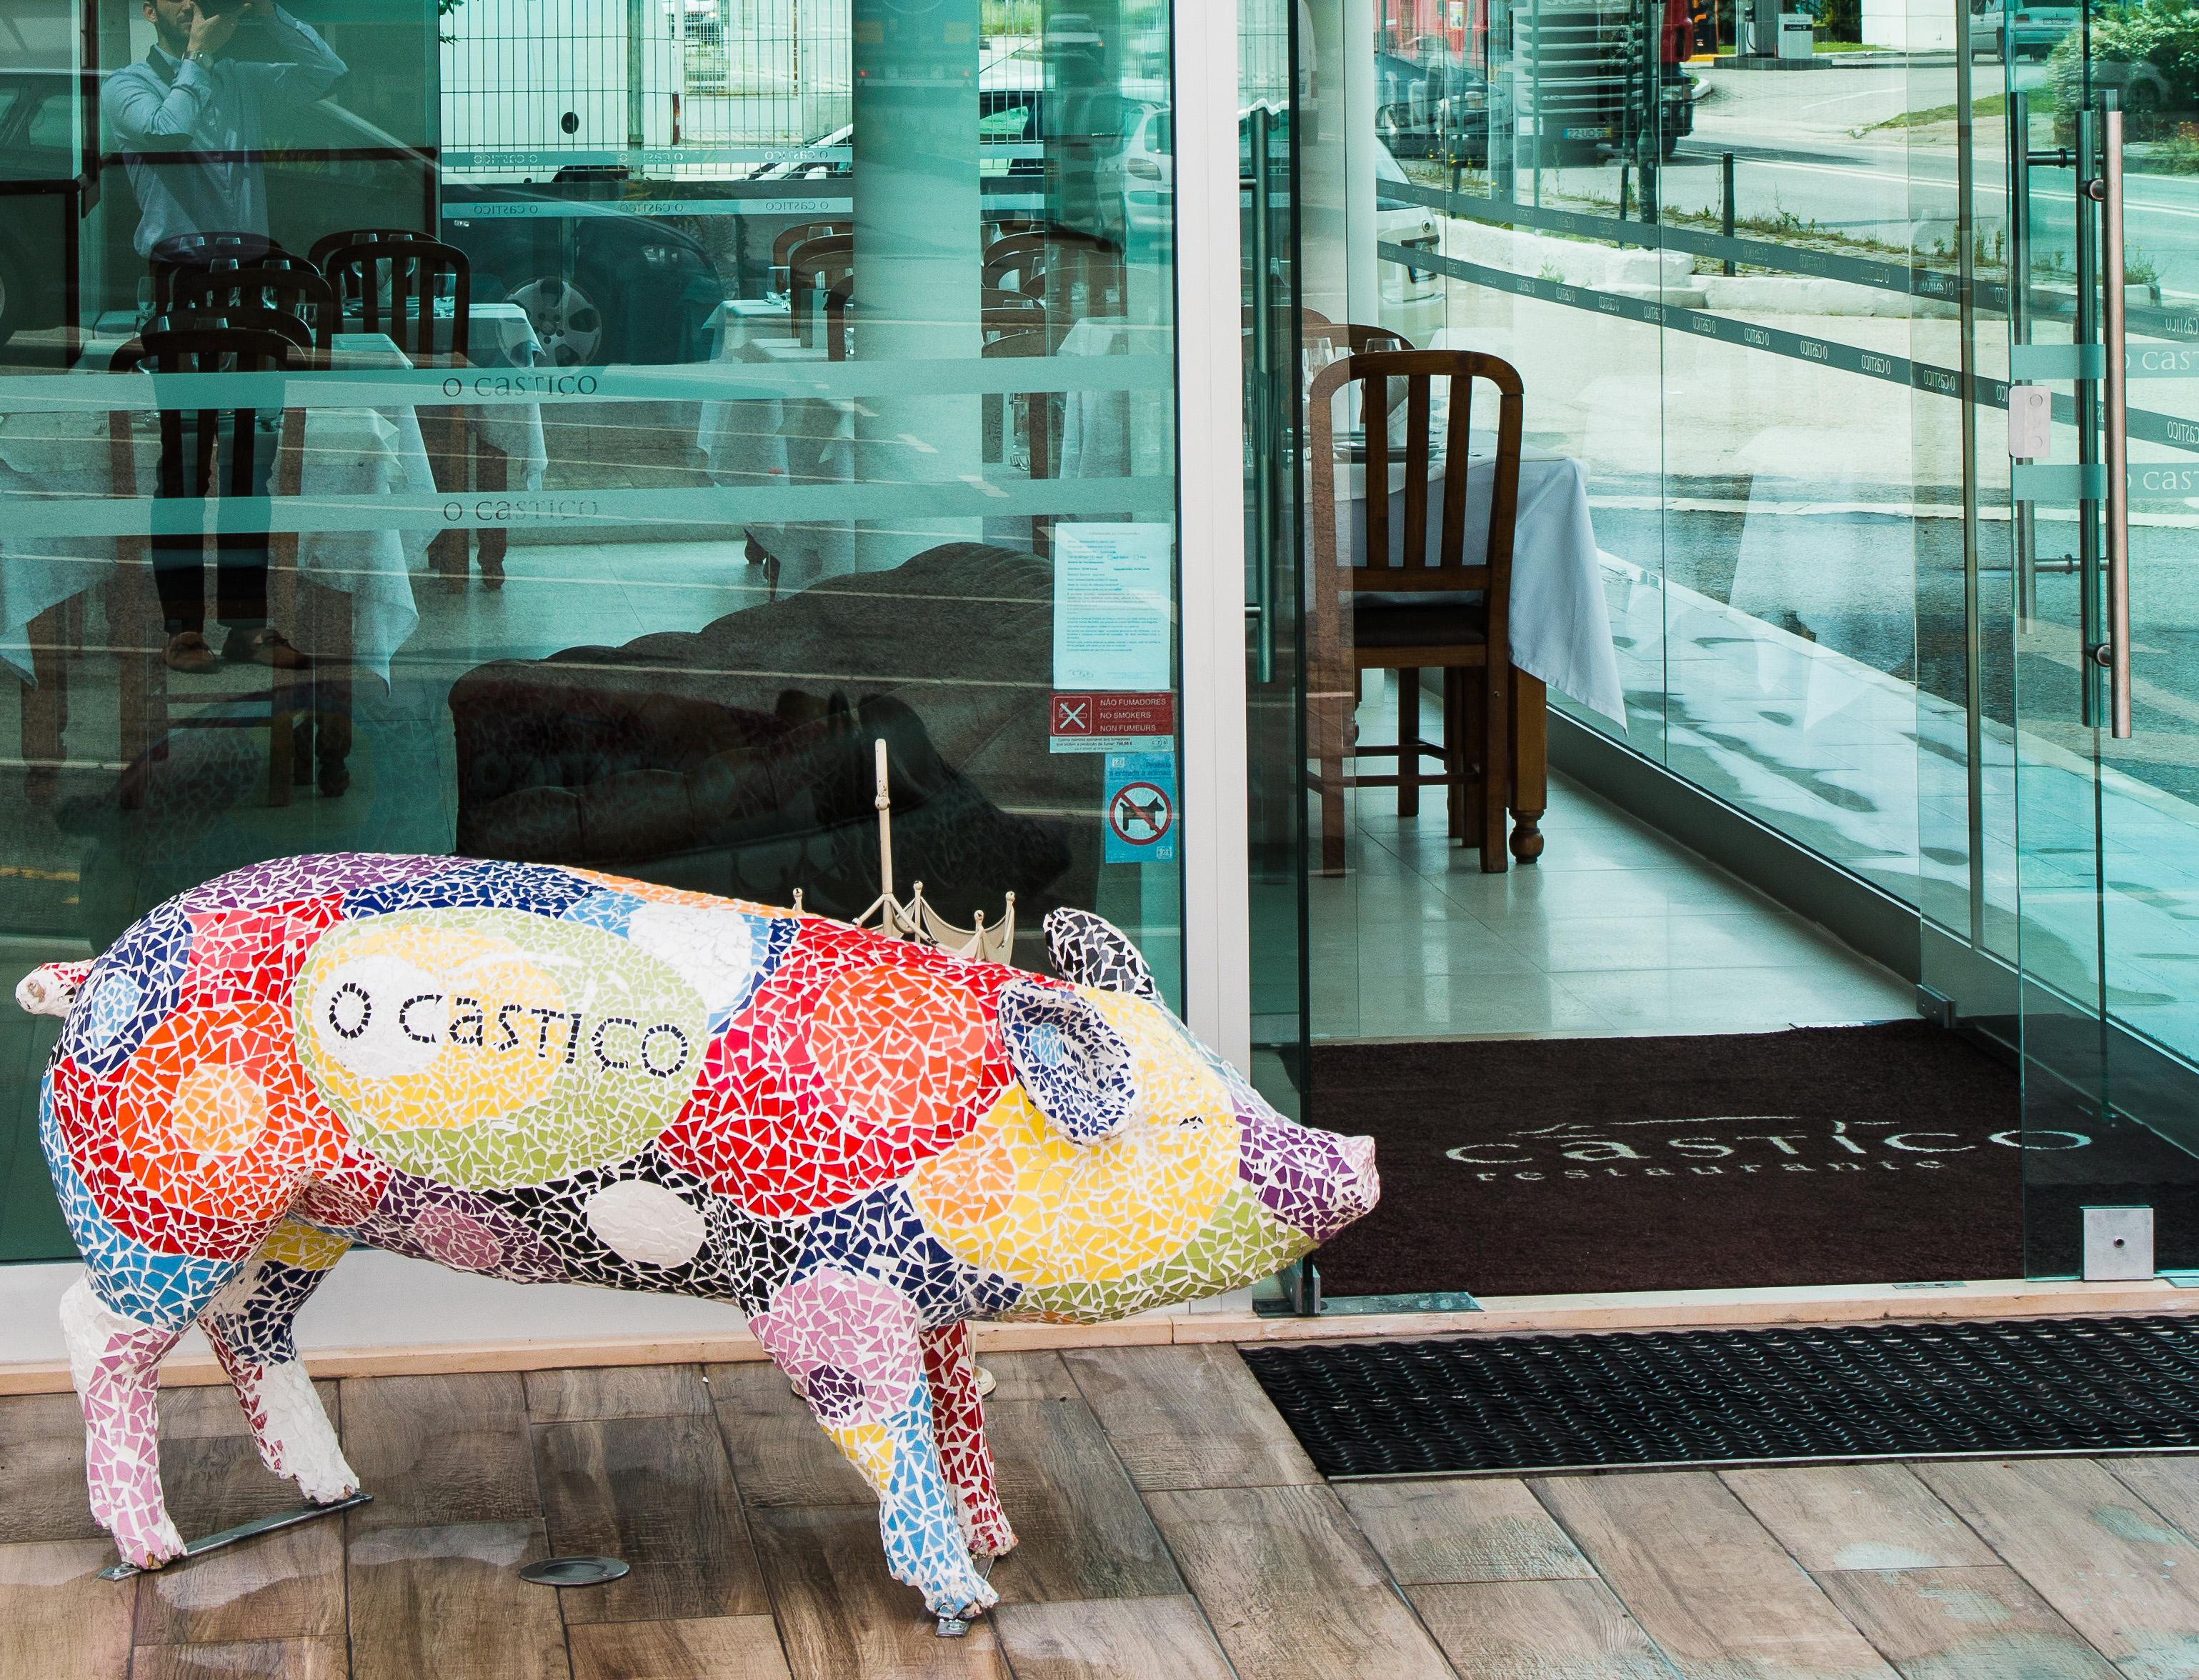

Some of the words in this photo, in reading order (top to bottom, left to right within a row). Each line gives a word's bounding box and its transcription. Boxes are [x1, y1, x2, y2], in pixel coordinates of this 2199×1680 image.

[442, 377, 462, 397] O
[443, 501, 462, 521] O
[329, 982, 372, 1040] O
